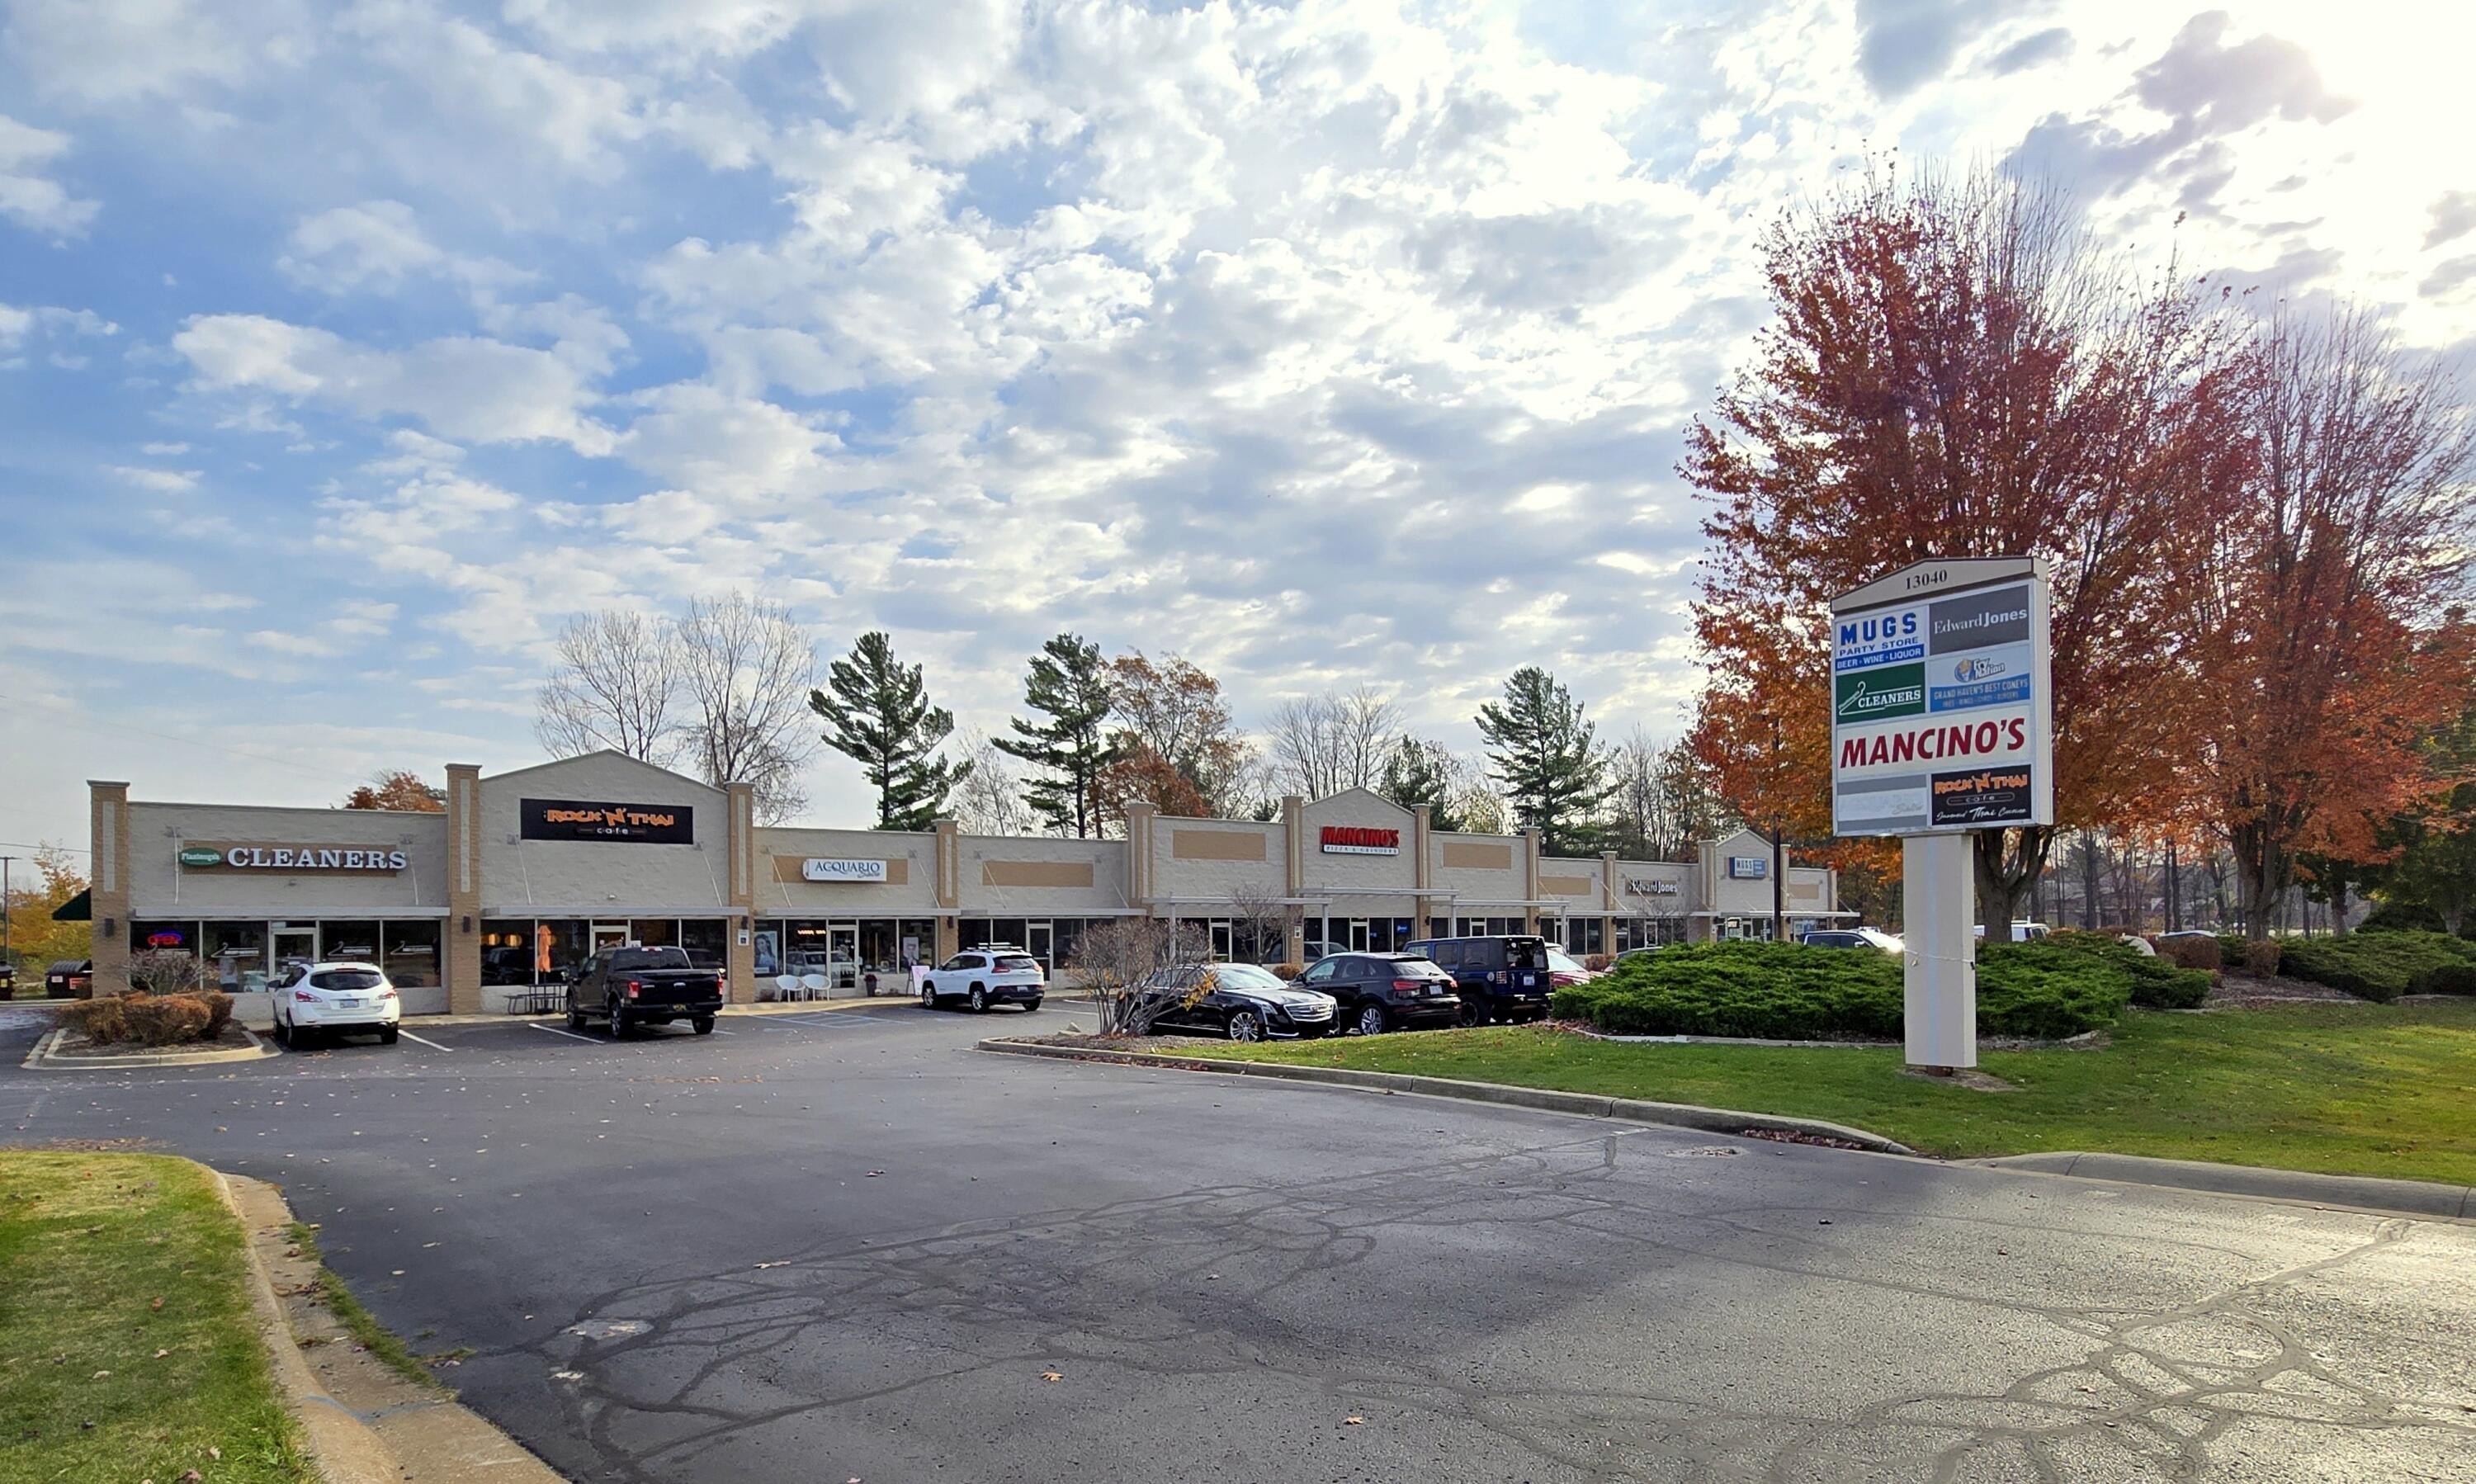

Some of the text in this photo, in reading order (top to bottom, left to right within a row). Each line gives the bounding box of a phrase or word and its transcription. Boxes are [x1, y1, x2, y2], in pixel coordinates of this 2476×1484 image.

[1907, 569, 1947, 589] 13040
[1840, 612, 1916, 646] MUGS
[1839, 636, 1919, 657] PARTY STORE
[1836, 648, 1921, 669] BEER WINE LIQUOR
[1858, 690, 1921, 708] CLEANERS
[1934, 678, 2028, 701] GRAND HAVEN'S BEST CONEYS
[1840, 718, 2025, 768] MANCINO'S
[1934, 778, 1973, 794] ROCK
[1991, 774, 2028, 789] THAI
[546, 809, 602, 823] ROCK
[626, 812, 674, 826] THAI
[1321, 826, 1400, 848] MANCINO'S
[227, 848, 407, 870] CLEANERS
[815, 862, 880, 875] ACQUARIO
